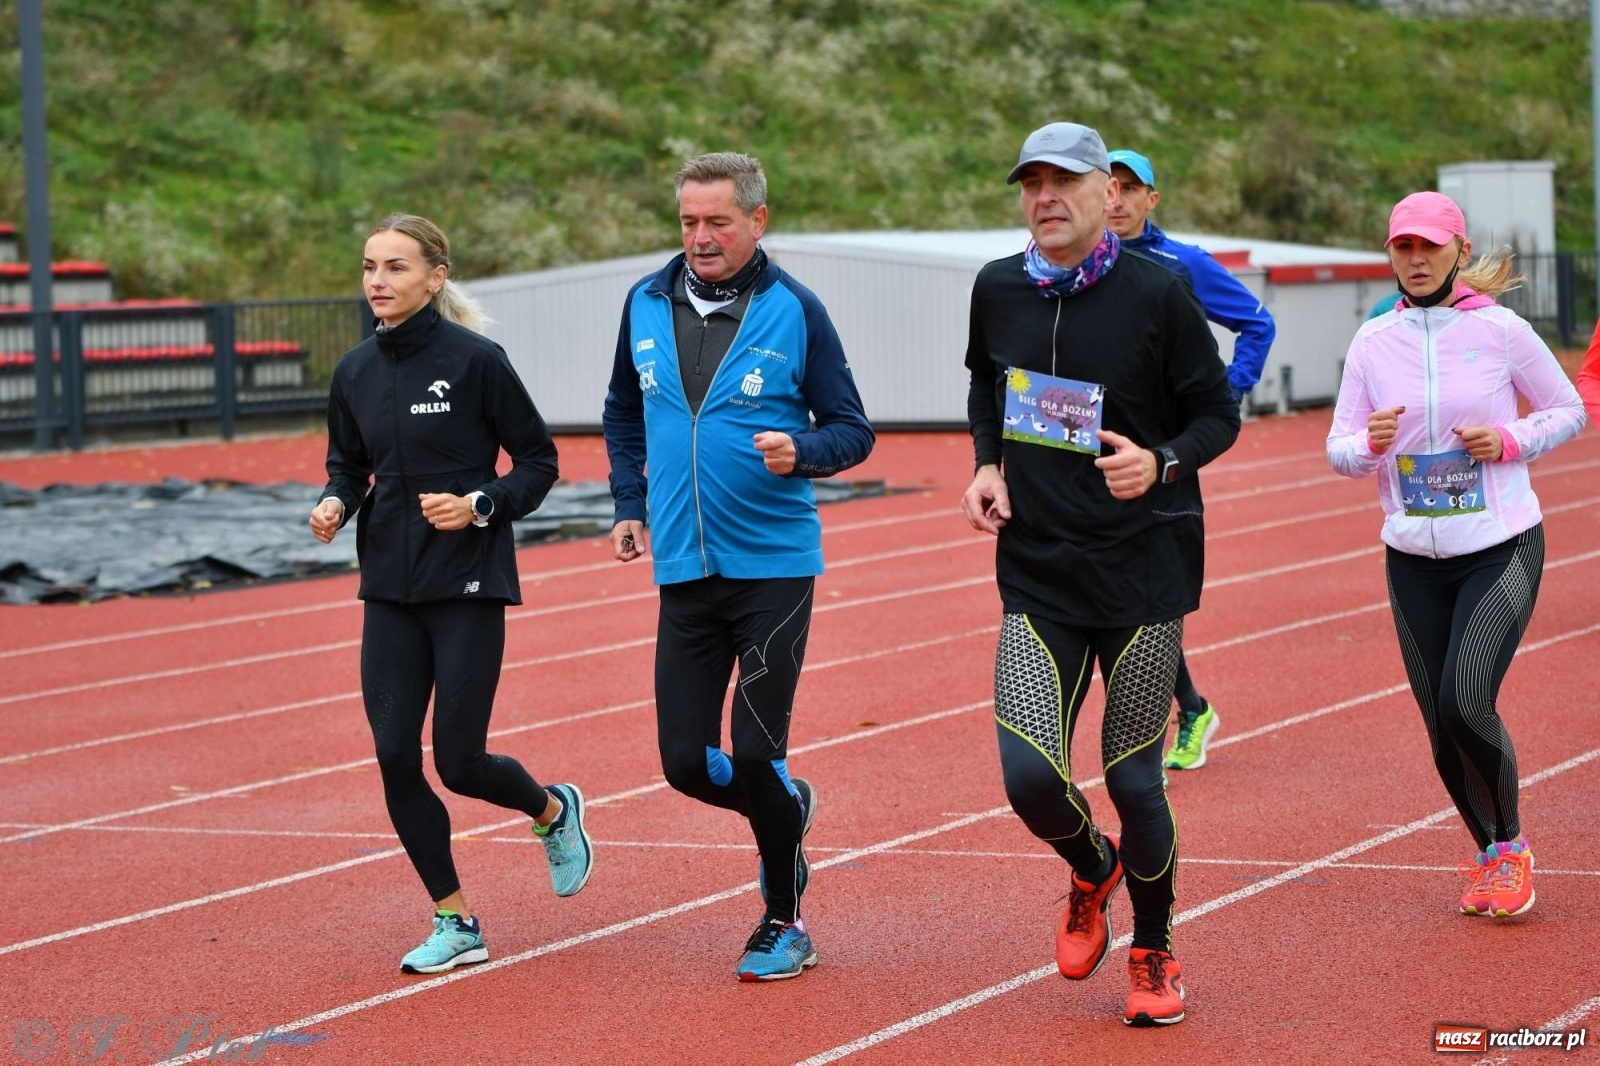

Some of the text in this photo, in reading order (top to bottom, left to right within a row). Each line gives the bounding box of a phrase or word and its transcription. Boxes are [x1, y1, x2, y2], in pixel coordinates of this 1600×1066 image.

[410, 401, 451, 415] ORLEN
[1018, 394, 1037, 406] BIEG
[1041, 400, 1058, 411] DLA
[1062, 427, 1092, 446] 125
[1408, 475, 1424, 485] BIEG
[1427, 475, 1442, 484] DLA
[1448, 493, 1478, 510] 087
